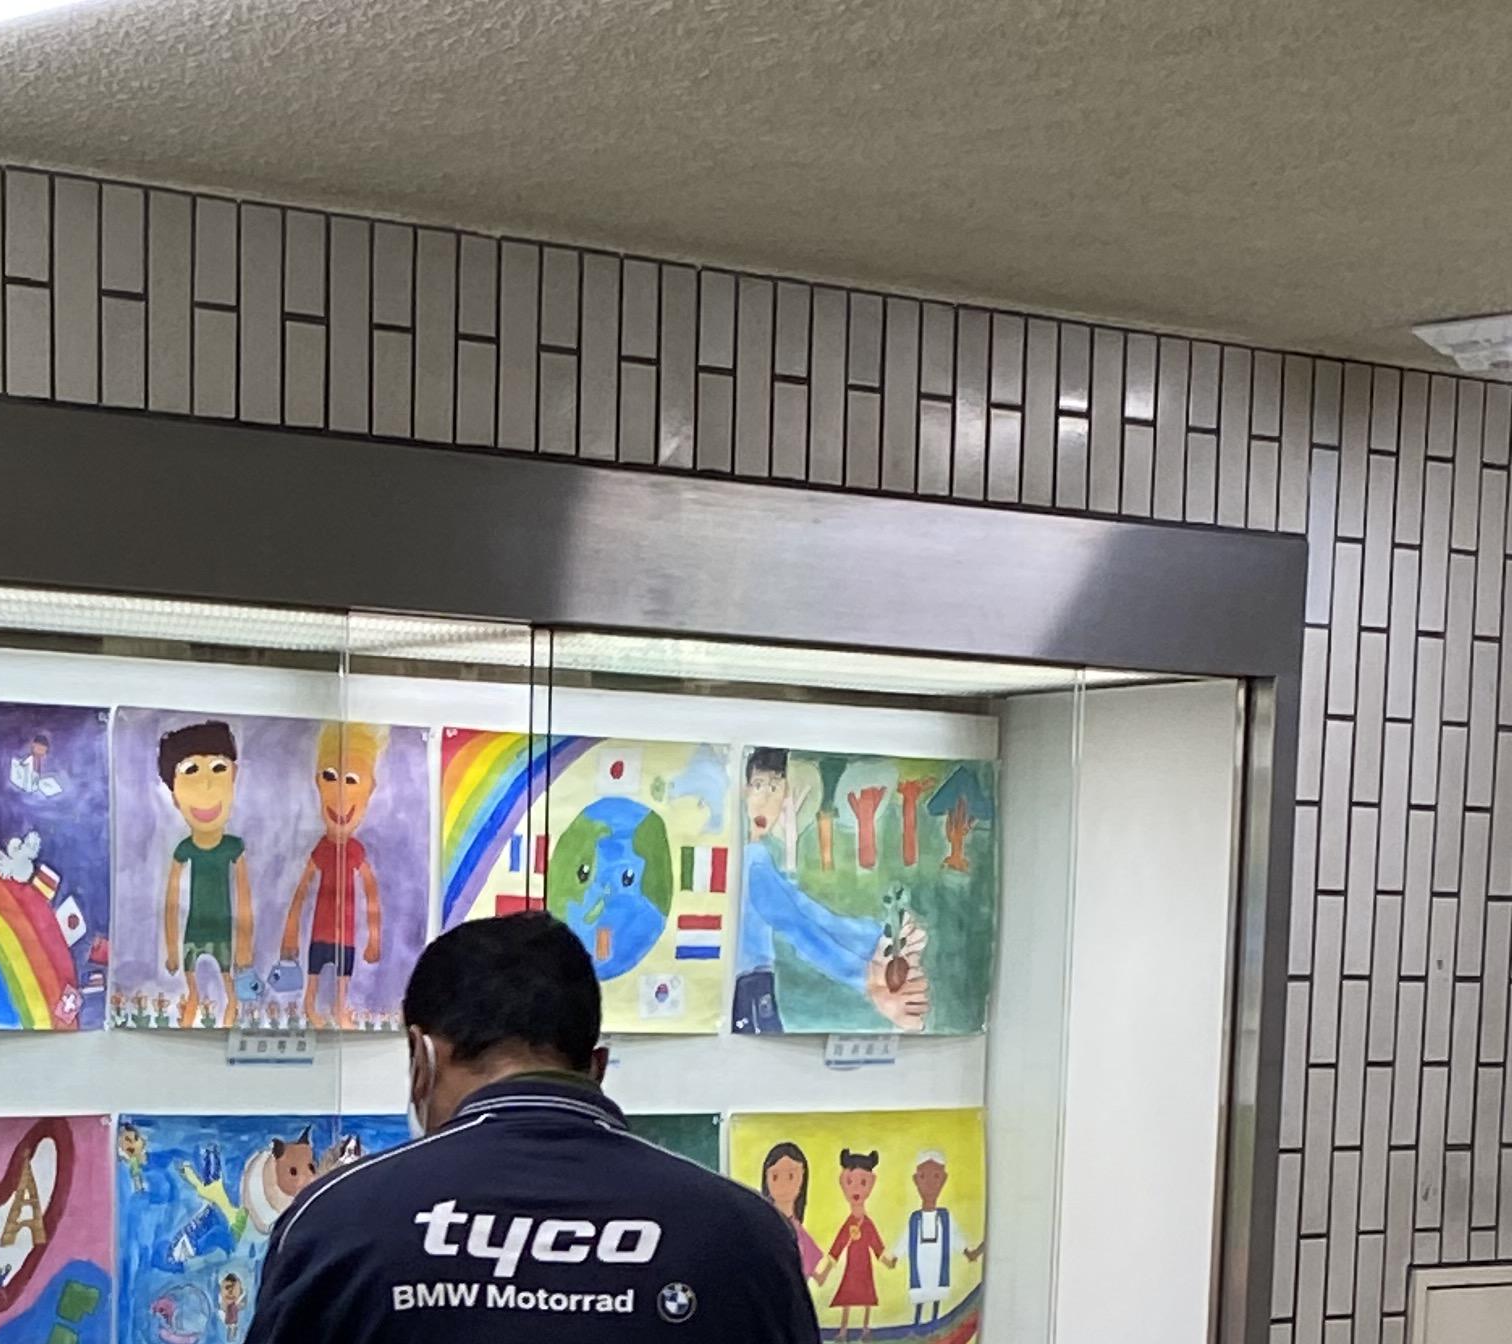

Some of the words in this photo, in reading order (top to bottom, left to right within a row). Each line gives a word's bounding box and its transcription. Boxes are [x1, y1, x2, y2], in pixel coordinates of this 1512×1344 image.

[414, 1200, 662, 1277] tyco
[392, 1282, 480, 1311] BMW
[486, 1284, 634, 1313] Motorrad
